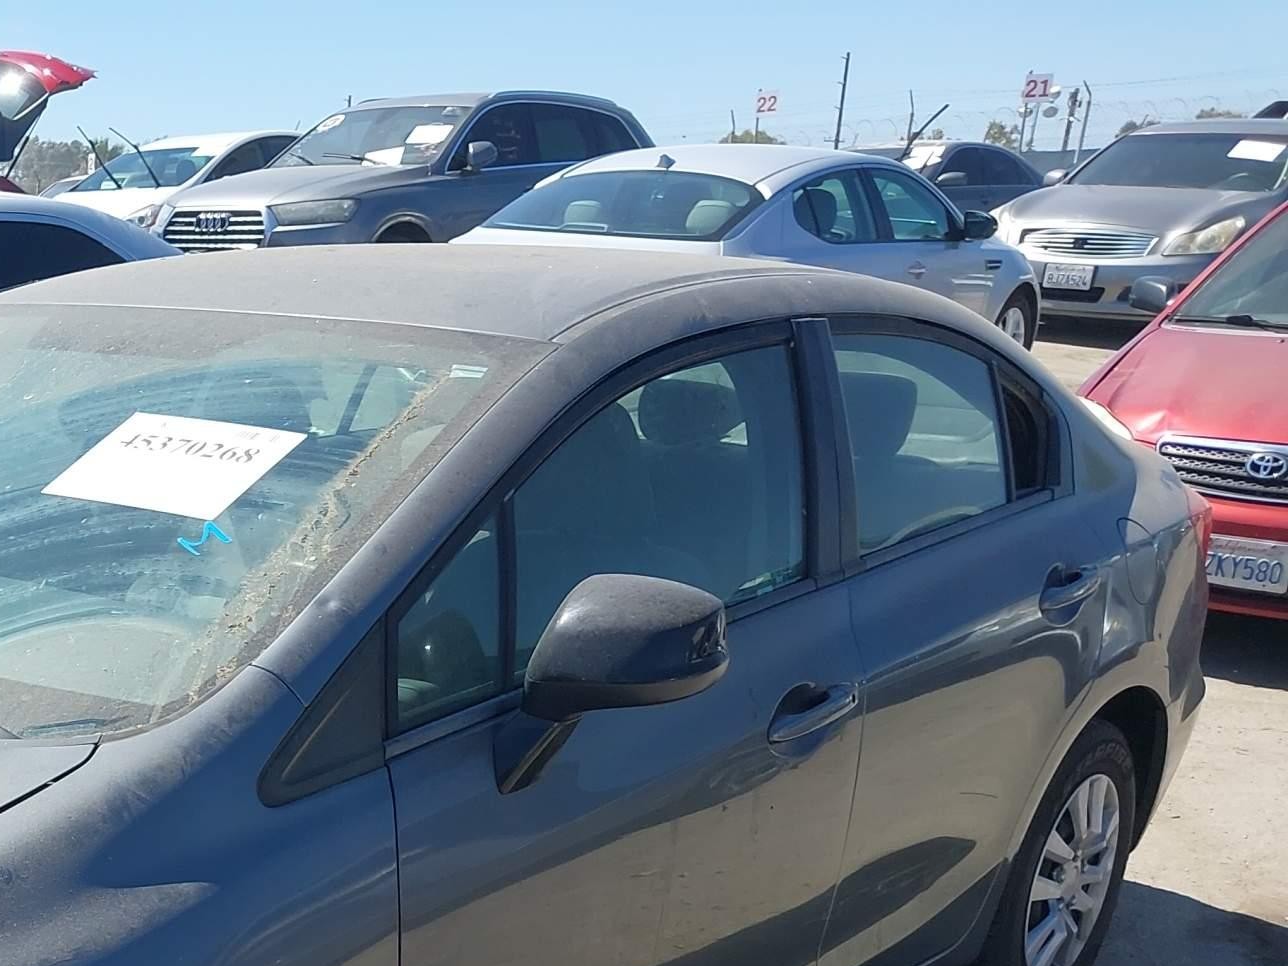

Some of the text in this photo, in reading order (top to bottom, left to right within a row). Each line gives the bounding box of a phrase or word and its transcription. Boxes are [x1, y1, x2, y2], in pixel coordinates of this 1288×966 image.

[1025, 79, 1049, 98] 21
[757, 95, 778, 113] 22
[120, 433, 261, 464] 45370268
